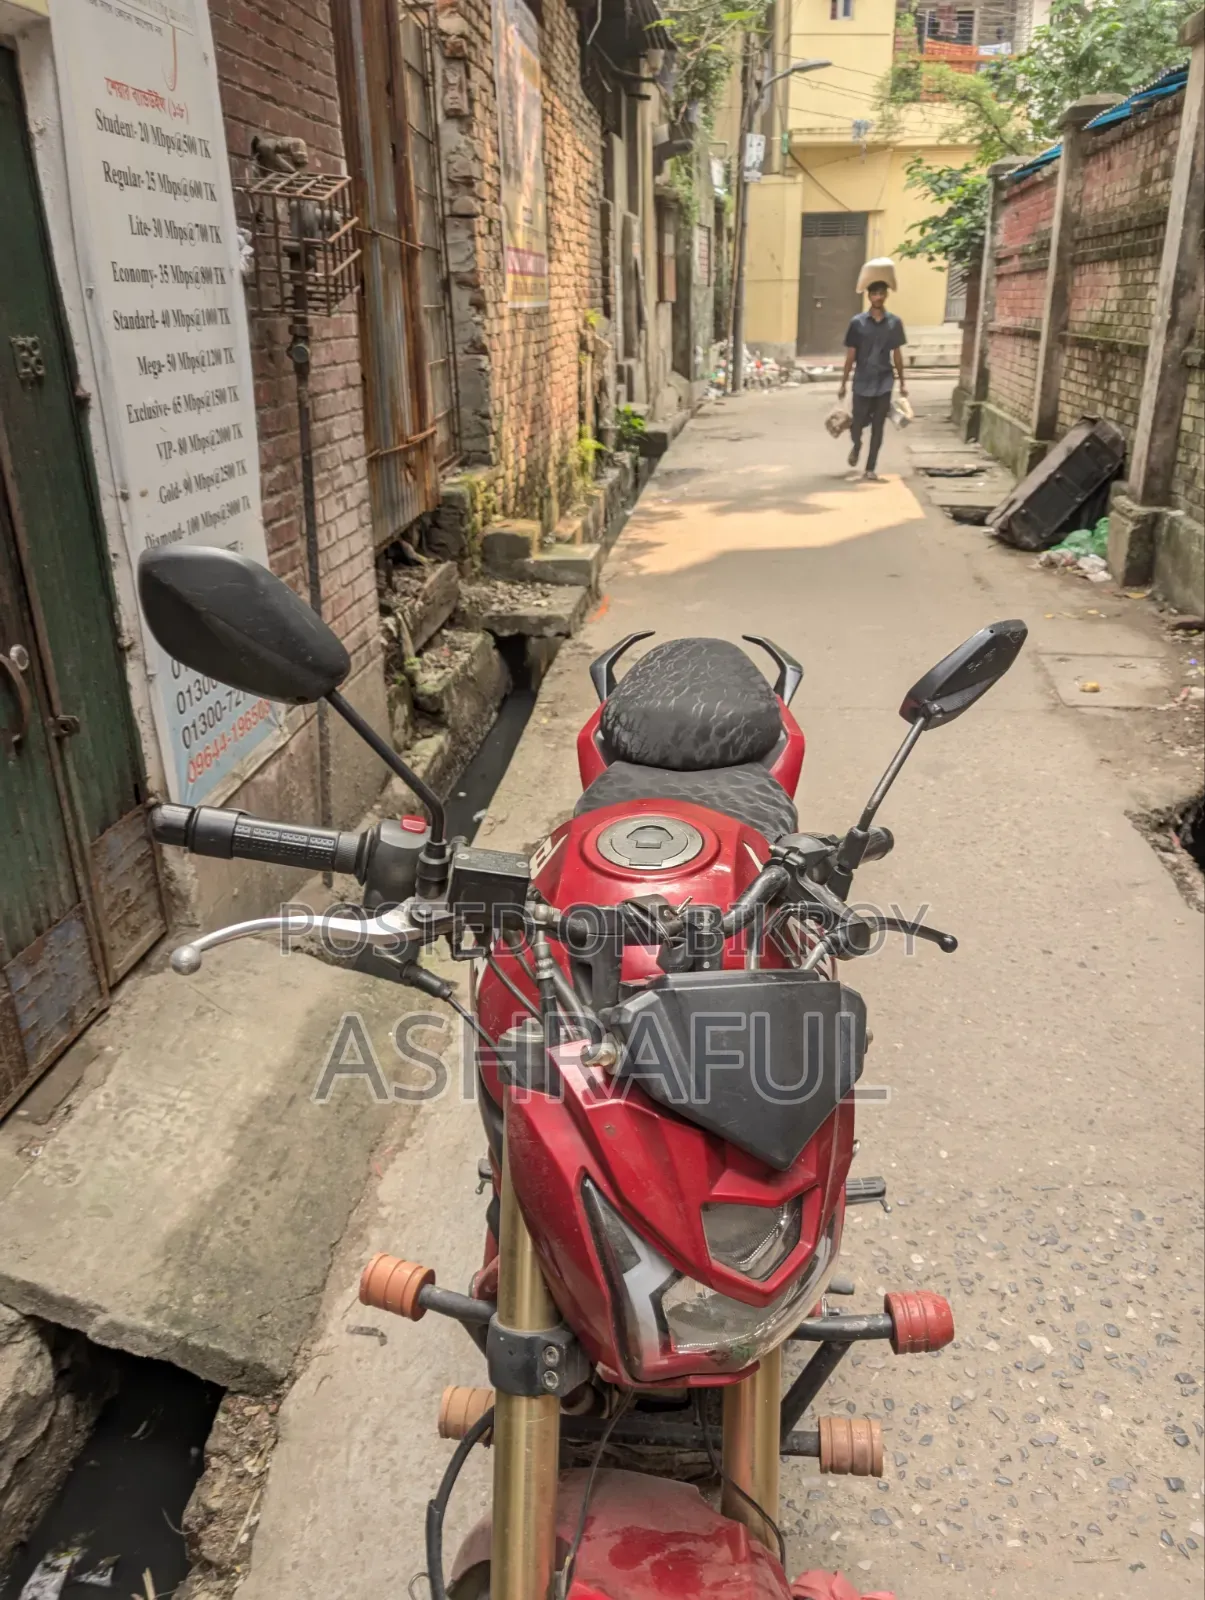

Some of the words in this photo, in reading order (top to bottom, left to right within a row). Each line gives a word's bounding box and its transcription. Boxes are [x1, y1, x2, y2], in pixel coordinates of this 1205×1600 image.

[95, 107, 138, 139] Student-
[138, 121, 150, 144] 20
[150, 124, 198, 158] Mbps@500
[198, 137, 212, 159] TK
[102, 160, 145, 191] Regular-
[145, 170, 156, 192] 25
[157, 172, 203, 202] Mbps@600
[203, 181, 217, 202] TK
[128, 214, 151, 236] Lite-
[151, 217, 163, 238] 30
[164, 219, 209, 247] Mbps@700
[209, 224, 222, 244] TK
[111, 261, 158, 289] Economy-
[158, 264, 169, 284] 35
[169, 265, 213, 289] Mbps@800
[213, 267, 226, 285] TK
[112, 309, 159, 331] Standard-
[161, 308, 171, 328] 40
[217, 307, 231, 325] TK
[136, 355, 166, 380] Mega-
[166, 353, 177, 373] 50
[223, 346, 235, 364] TK
[126, 400, 172, 424] Exclusive-
[172, 395, 182, 414] 65
[227, 385, 240, 402] TK
[156, 441, 177, 460] VIP-
[231, 423, 244, 440] TK
[159, 481, 182, 504] Gold-
[236, 458, 248, 476] TK
